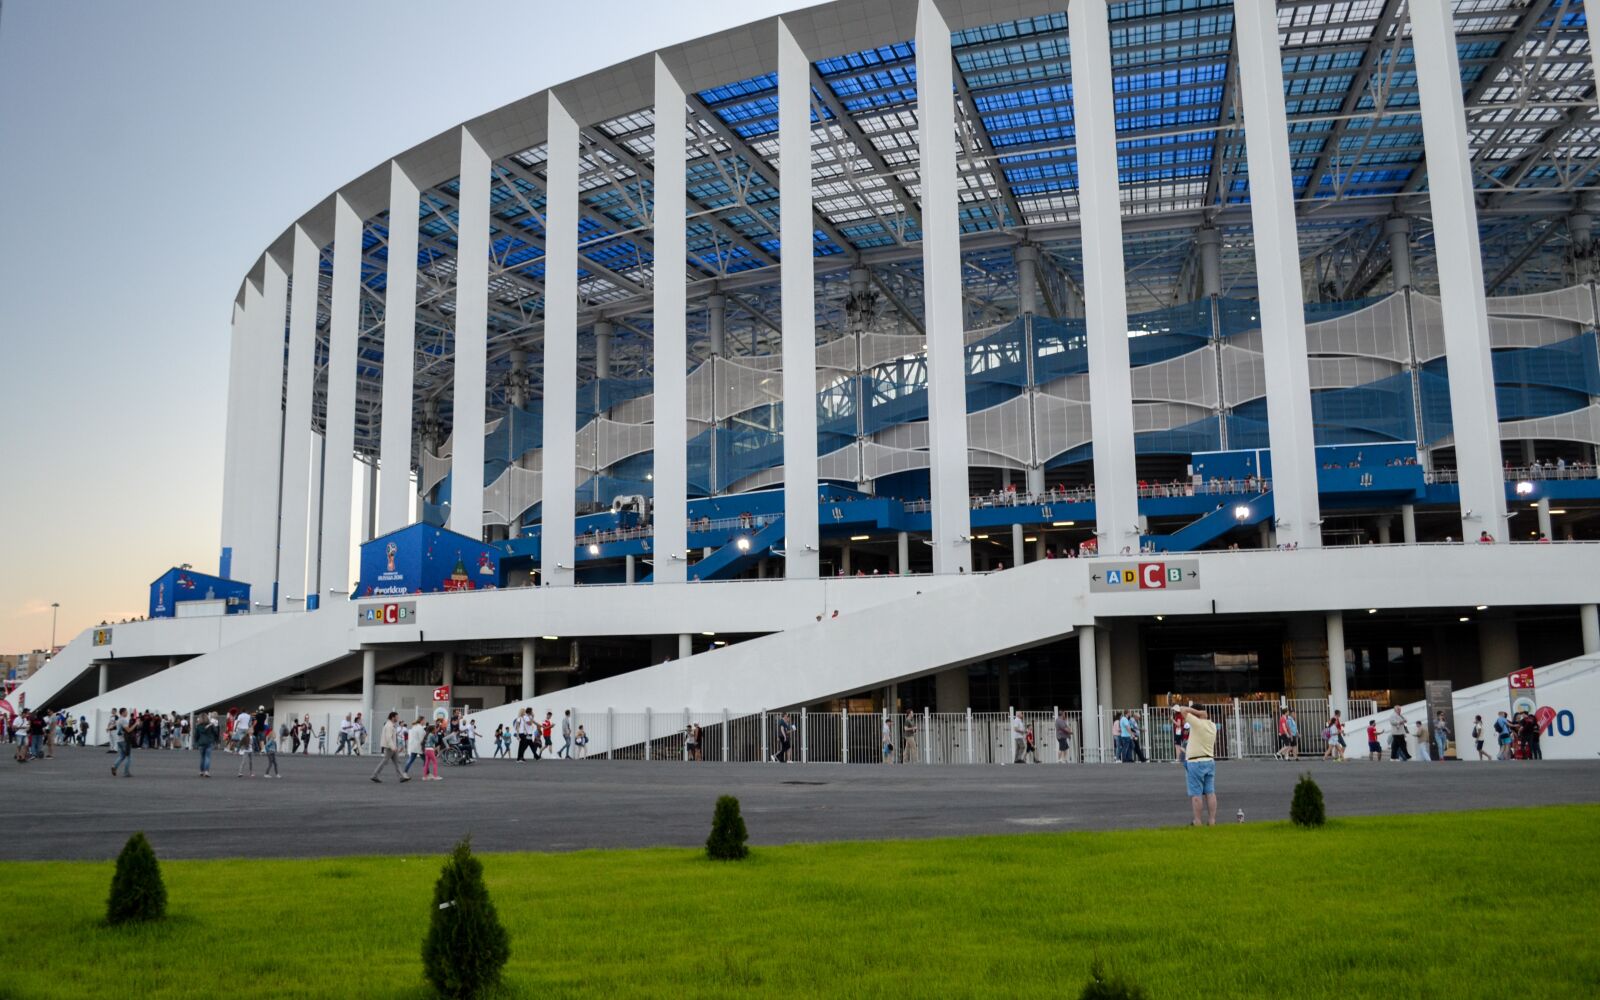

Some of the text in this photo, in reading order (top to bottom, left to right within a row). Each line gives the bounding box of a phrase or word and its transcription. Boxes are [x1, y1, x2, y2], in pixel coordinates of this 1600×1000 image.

[1109, 564, 1180, 588] A D C B
[368, 610, 374, 620] A
[386, 605, 396, 623] C
[1510, 674, 1520, 688] C
[434, 690, 440, 700] C
